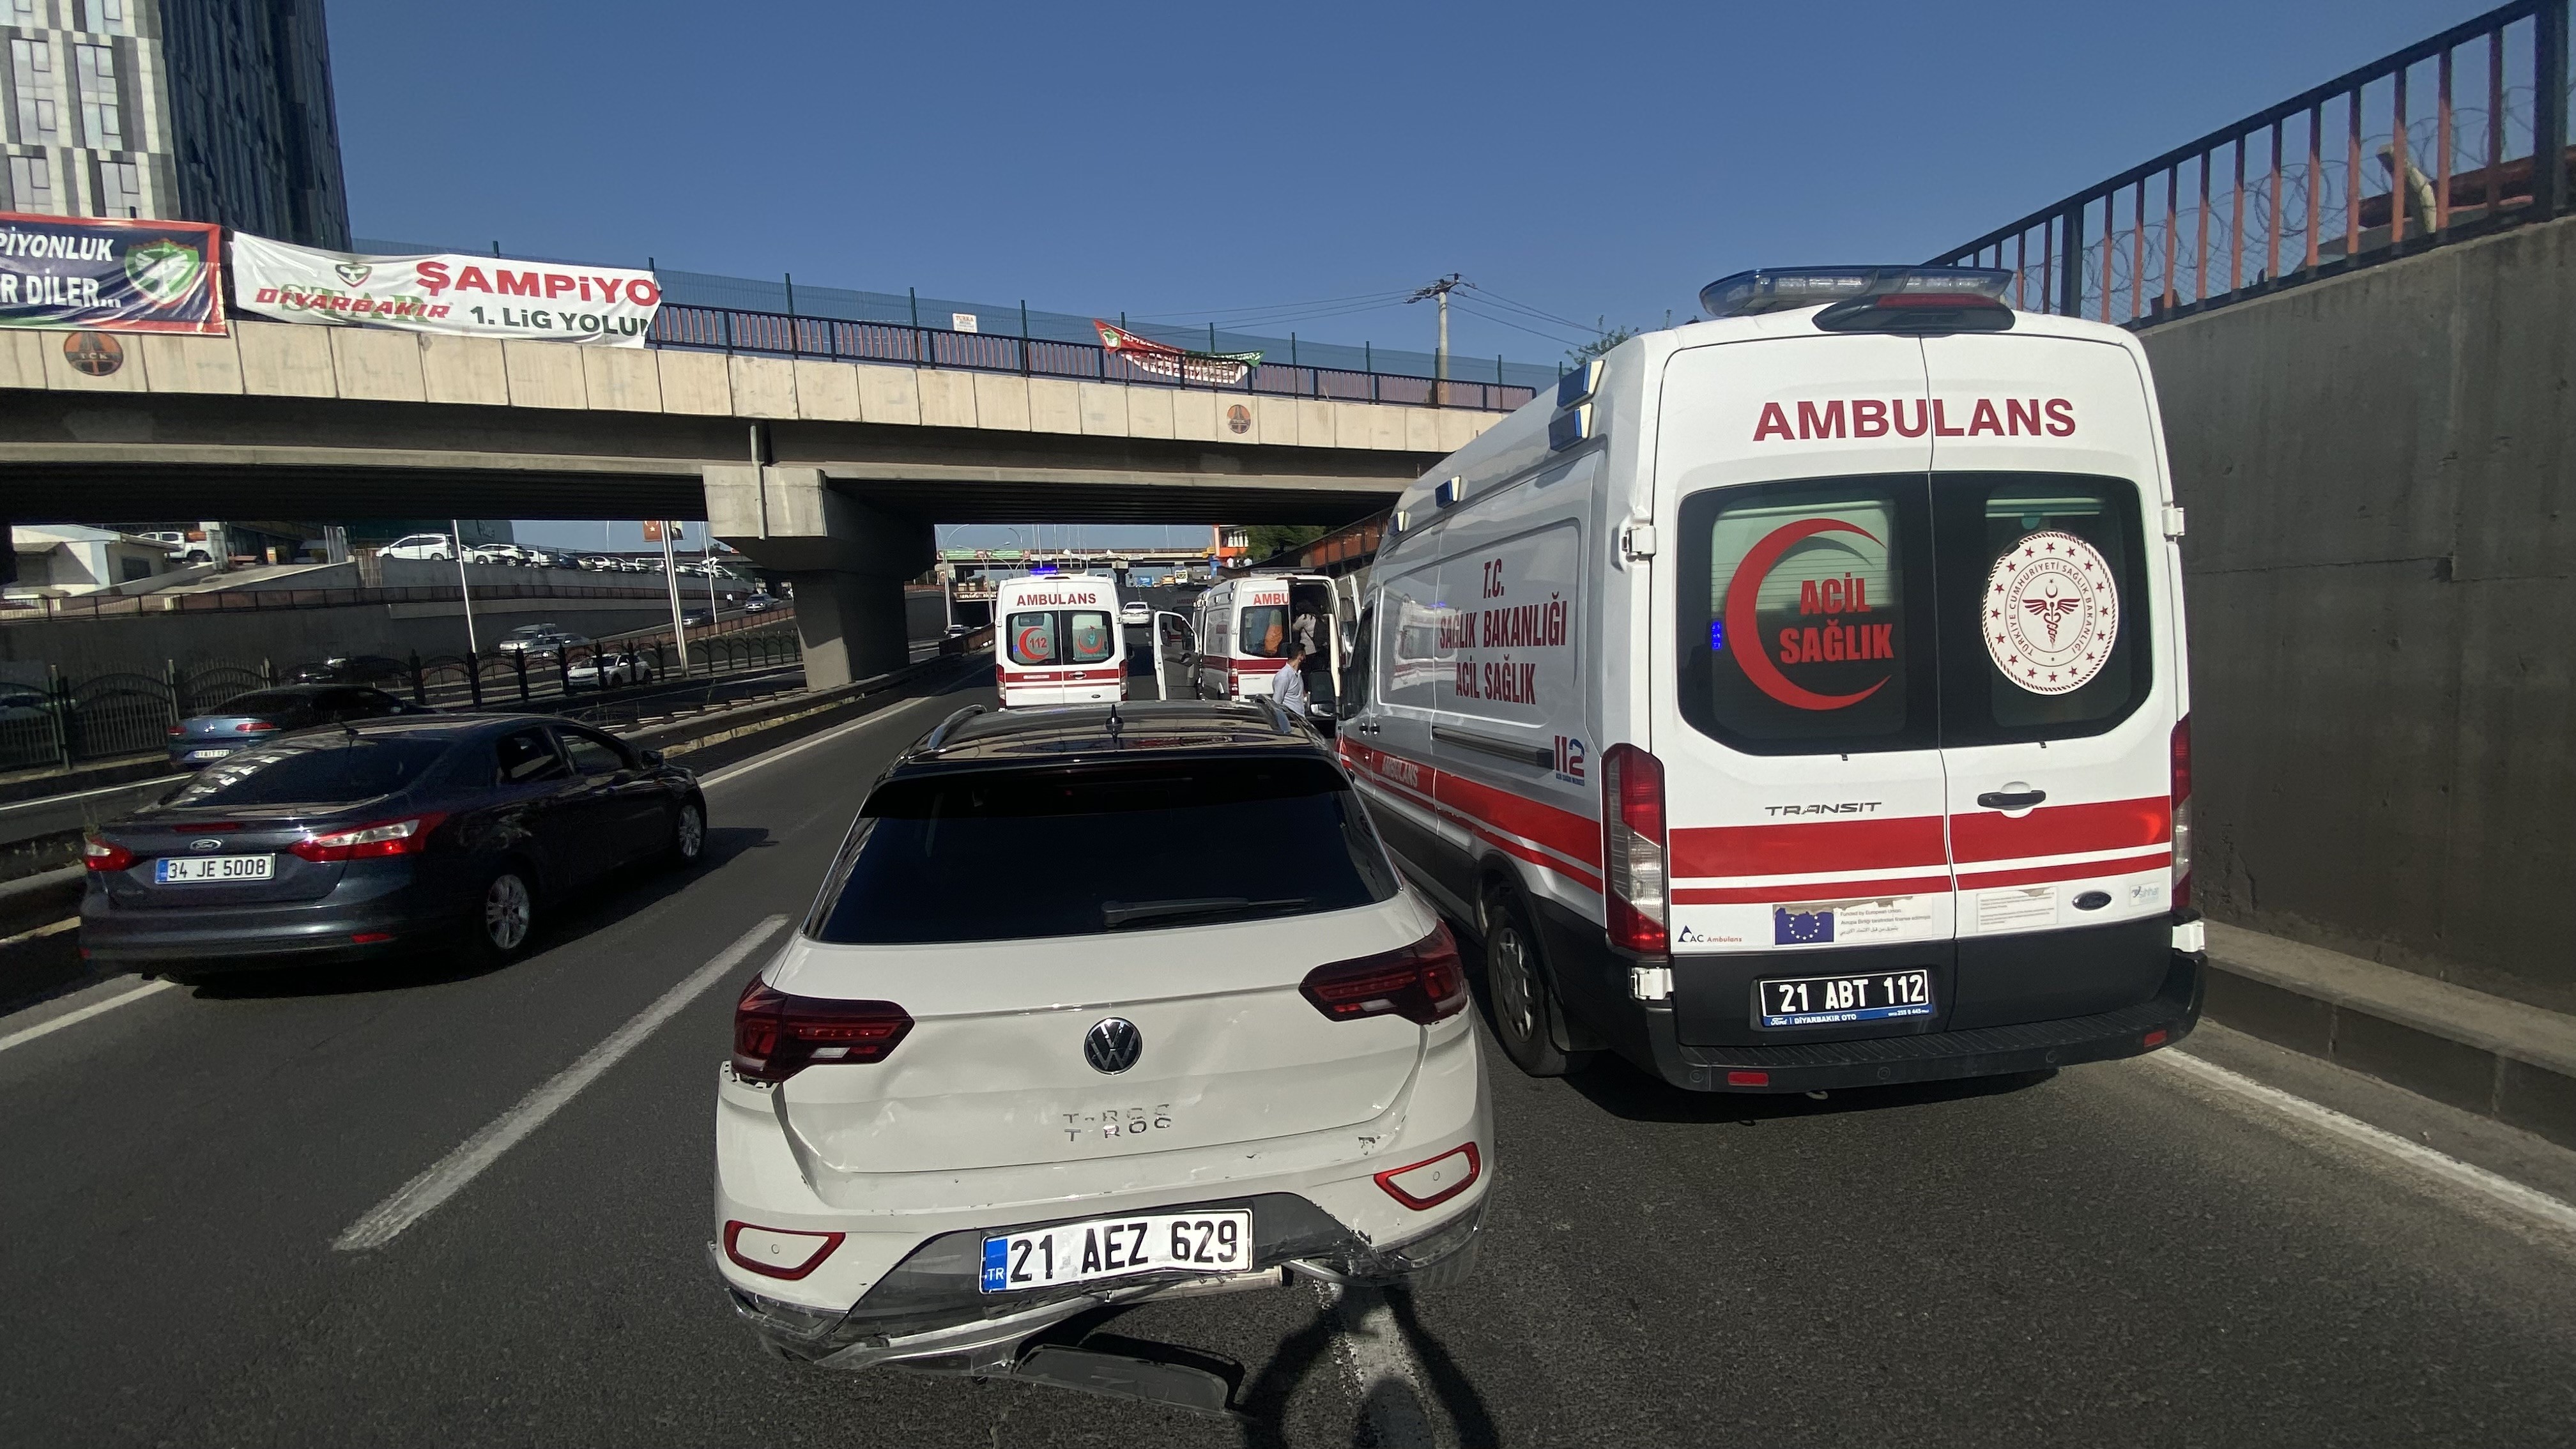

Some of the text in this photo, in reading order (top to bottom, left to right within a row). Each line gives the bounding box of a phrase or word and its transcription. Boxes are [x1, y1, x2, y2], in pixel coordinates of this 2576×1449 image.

[26, 268, 121, 308] DİLER...
[470, 306, 495, 325] 1.
[1753, 398, 2077, 441] AMBULANS
[1483, 558, 1505, 599] T.C.
[1800, 572, 1871, 617] ACİL
[2009, 561, 2059, 610] CUMHURİYETİ
[2062, 564, 2089, 595] SAĞLIK
[1016, 594, 1096, 606] AMBULANS
[1439, 591, 1568, 649] SAĞLIK BAKANLIĞI
[1029, 637, 1047, 648] 112
[1779, 620, 1895, 664] SAĞLIK
[2072, 597, 2093, 654] BAKANLIĞI
[1456, 654, 1536, 705] ACİL SAĞLIK
[1554, 735, 1584, 778] 112
[1765, 802, 1882, 816] TRANSIT
[169, 859, 266, 878] 34 JE 5008
[1779, 974, 1924, 1013] 21 ABT 112
[1770, 1017, 1788, 1025] Ford
[987, 1220, 1238, 1283] TR 21 AEZ 629
